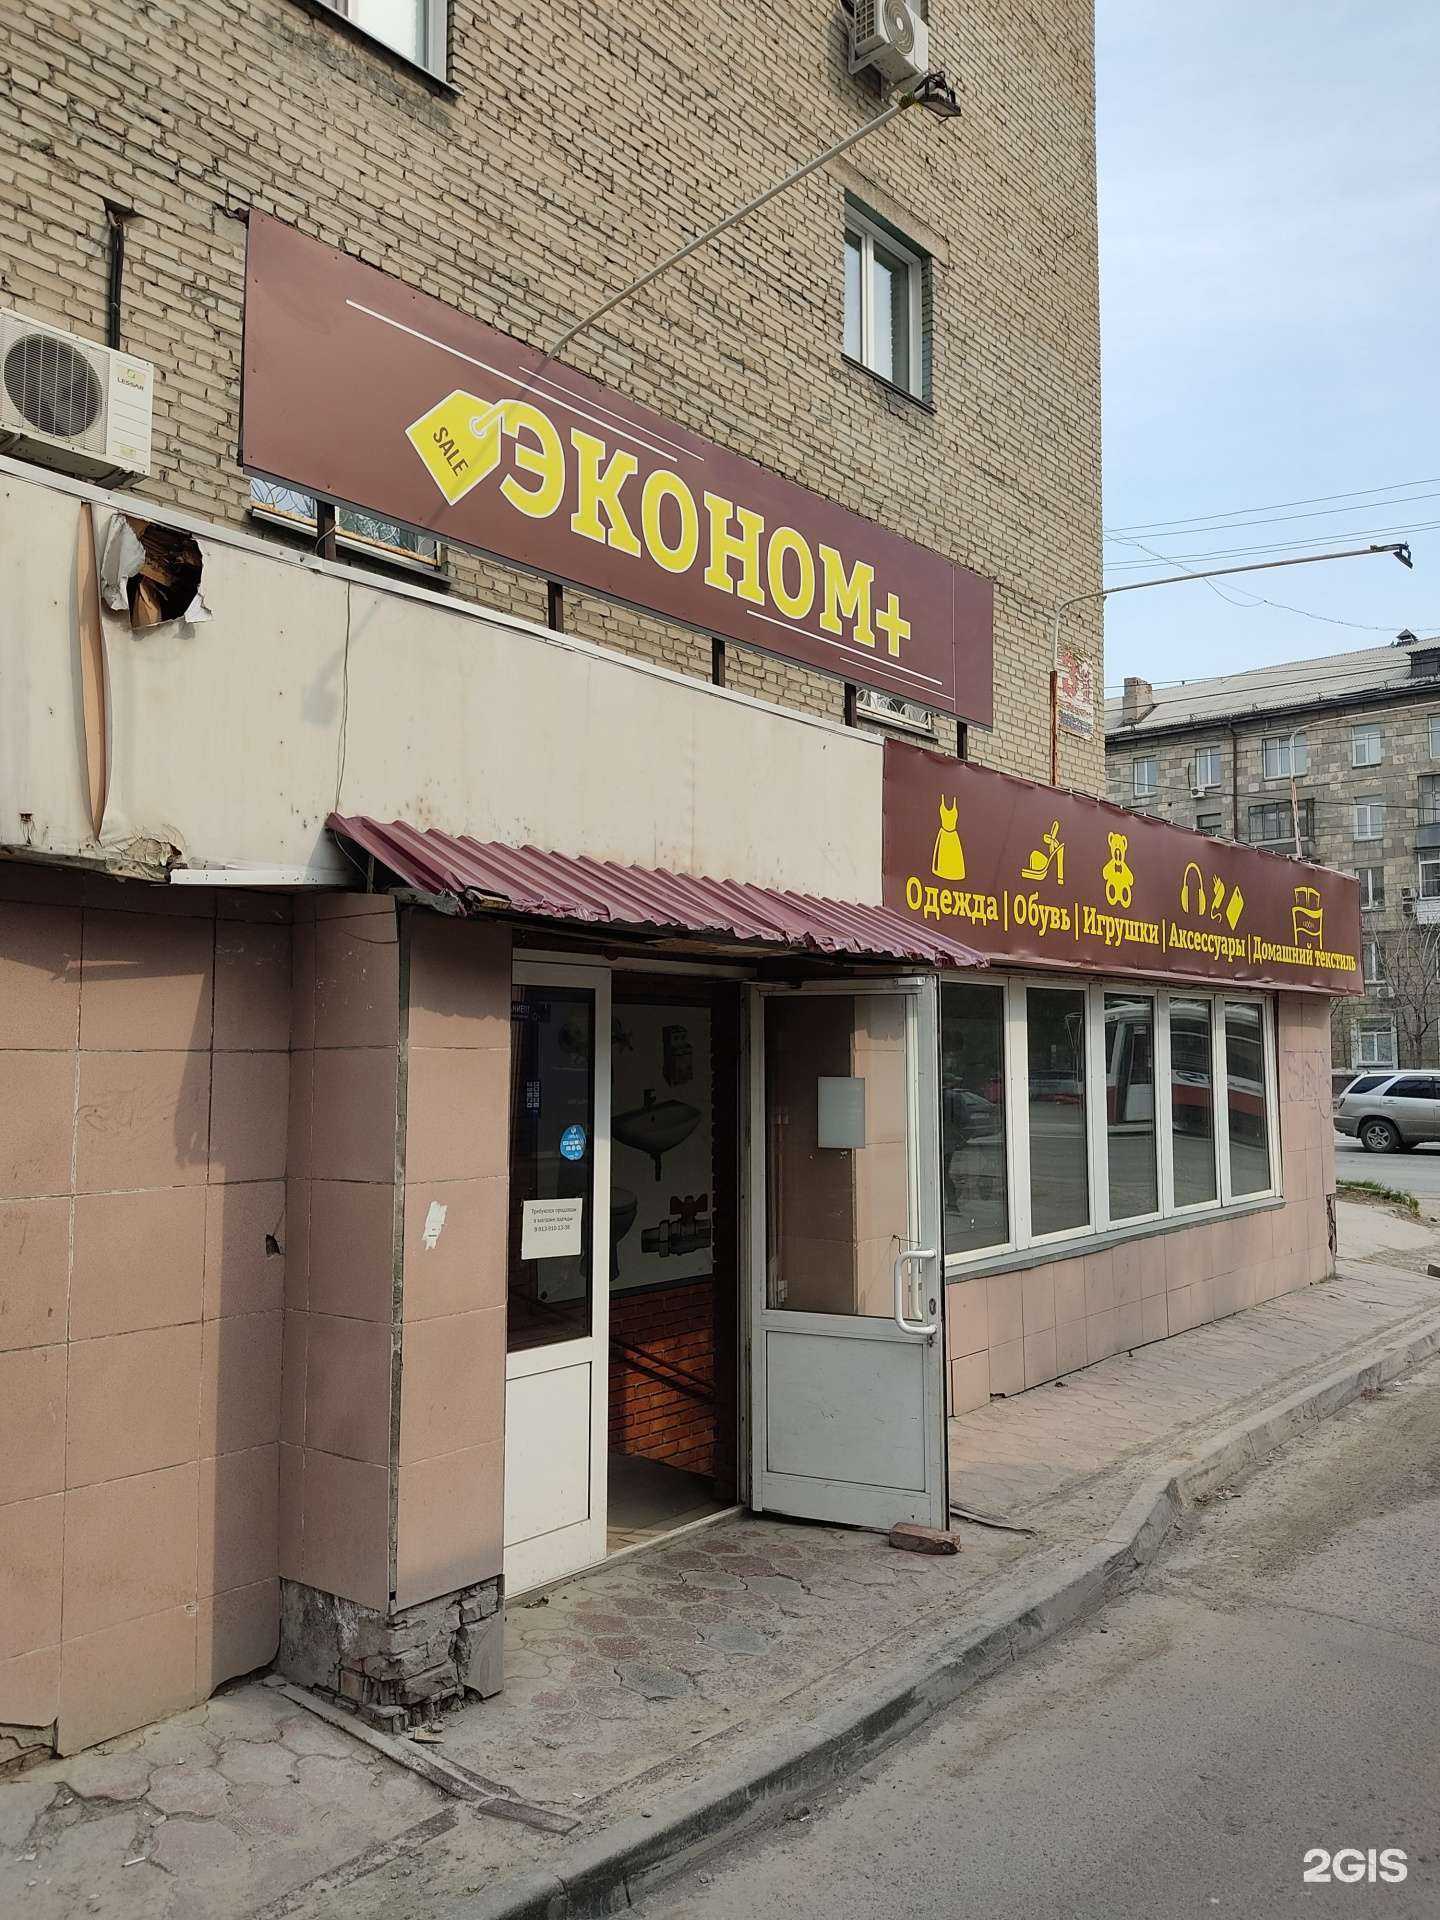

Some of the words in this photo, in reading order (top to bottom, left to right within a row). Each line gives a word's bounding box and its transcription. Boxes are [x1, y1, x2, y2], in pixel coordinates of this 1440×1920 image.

[433, 426, 469, 477] SALE
[499, 399, 911, 658] ЭКОНОМ+
[906, 876, 999, 927] Одежда
[1013, 891, 1071, 936] Обувь
[1083, 906, 1159, 947] Игрушки
[1169, 922, 1245, 963] Аксессуары
[1253, 936, 1313, 966] Домашний
[1314, 949, 1357, 972] текстиль
